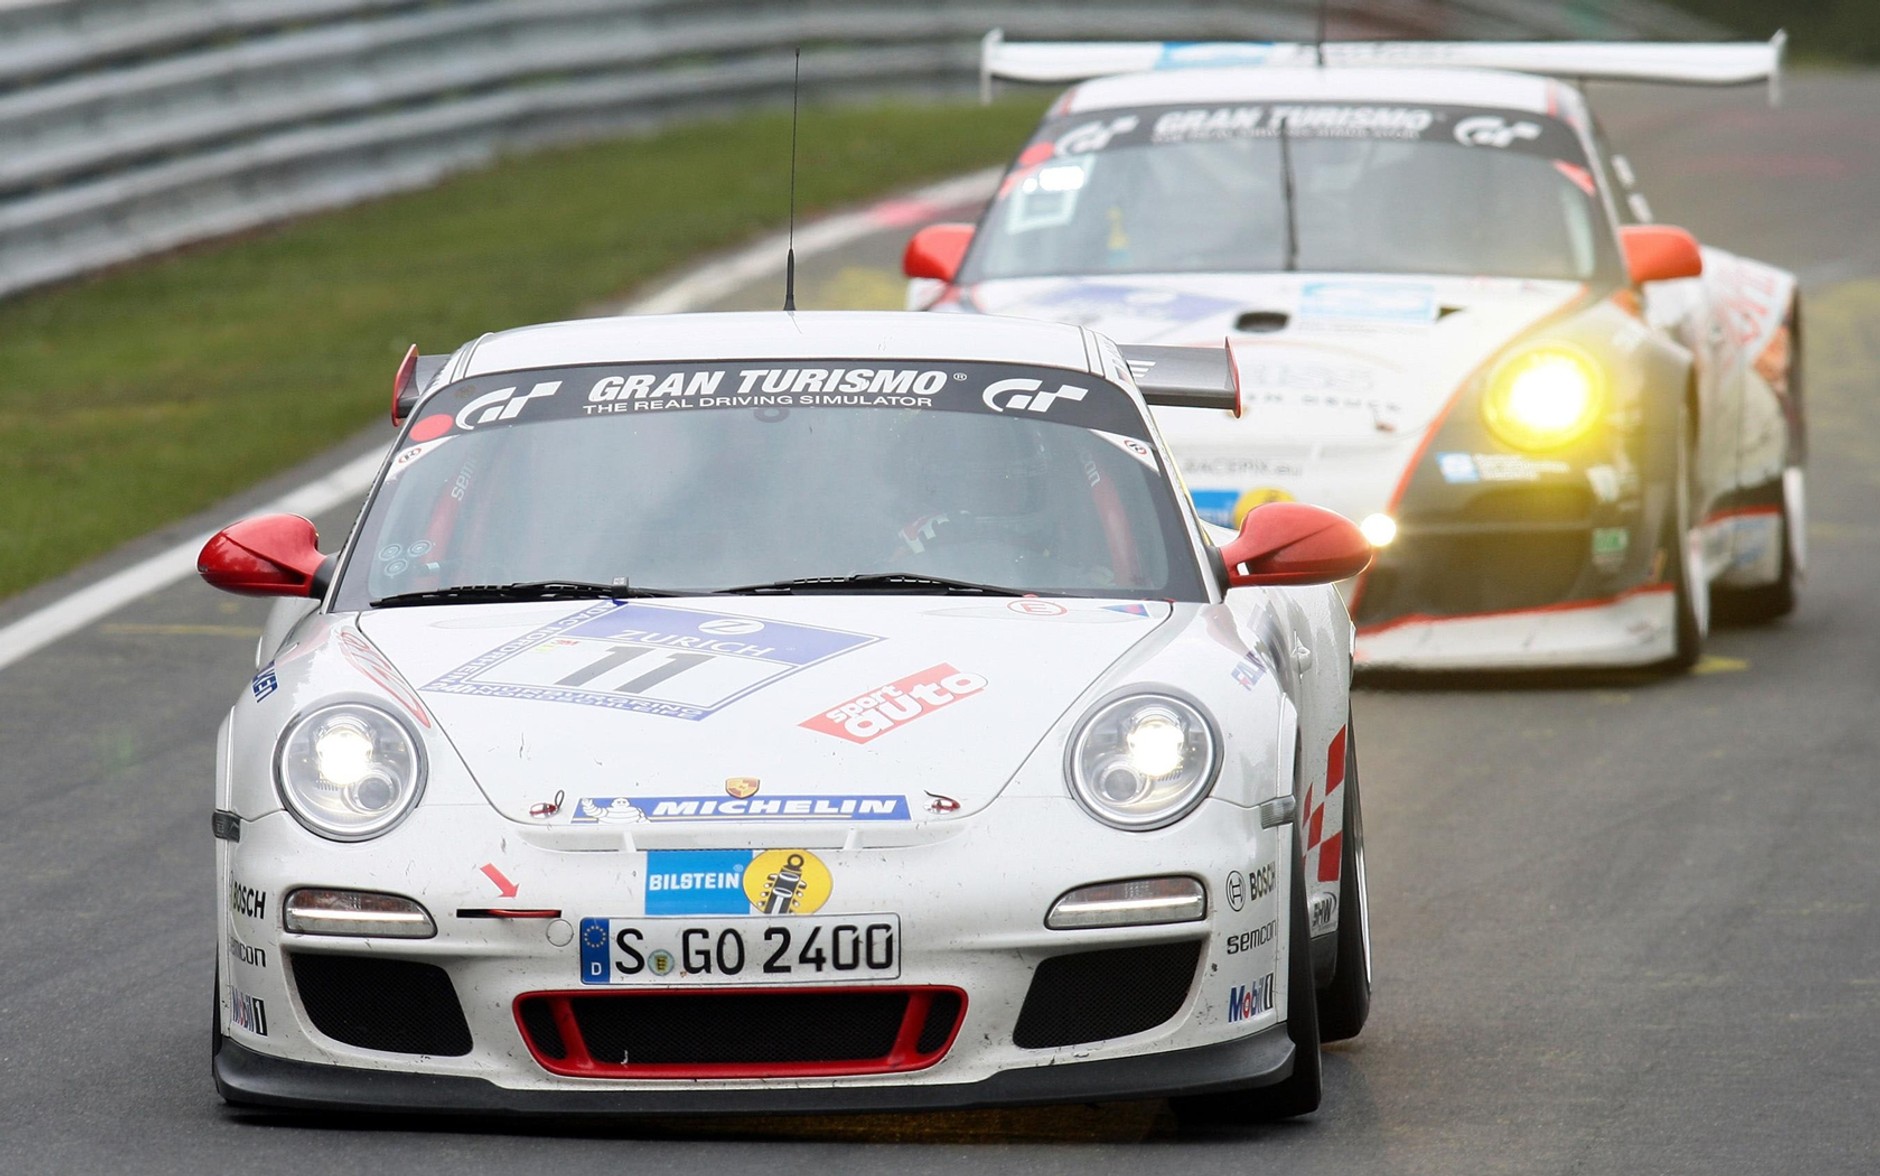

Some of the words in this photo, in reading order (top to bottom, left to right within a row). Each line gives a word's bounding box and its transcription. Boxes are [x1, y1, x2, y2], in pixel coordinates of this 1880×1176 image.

[1153, 105, 1264, 134] GRAN
[1266, 104, 1433, 131] TURISMO
[588, 370, 726, 402] GRAN
[739, 368, 948, 395] TURISMO
[583, 404, 627, 414] THE
[634, 399, 694, 411] REAL
[700, 395, 793, 407] DRIVING
[800, 394, 933, 407] SIMULATOR
[608, 629, 776, 657] ZURICH
[554, 645, 718, 694] 11
[826, 684, 906, 722] sport
[844, 672, 989, 738] auto
[652, 798, 900, 816] MICHELIN
[649, 872, 740, 891] BILSTEIN
[1249, 861, 1276, 901] BOSCH
[614, 929, 645, 975] S
[682, 928, 746, 976] GO
[762, 923, 894, 973] 2400
[1227, 919, 1277, 955] semcon
[591, 961, 602, 976] D
